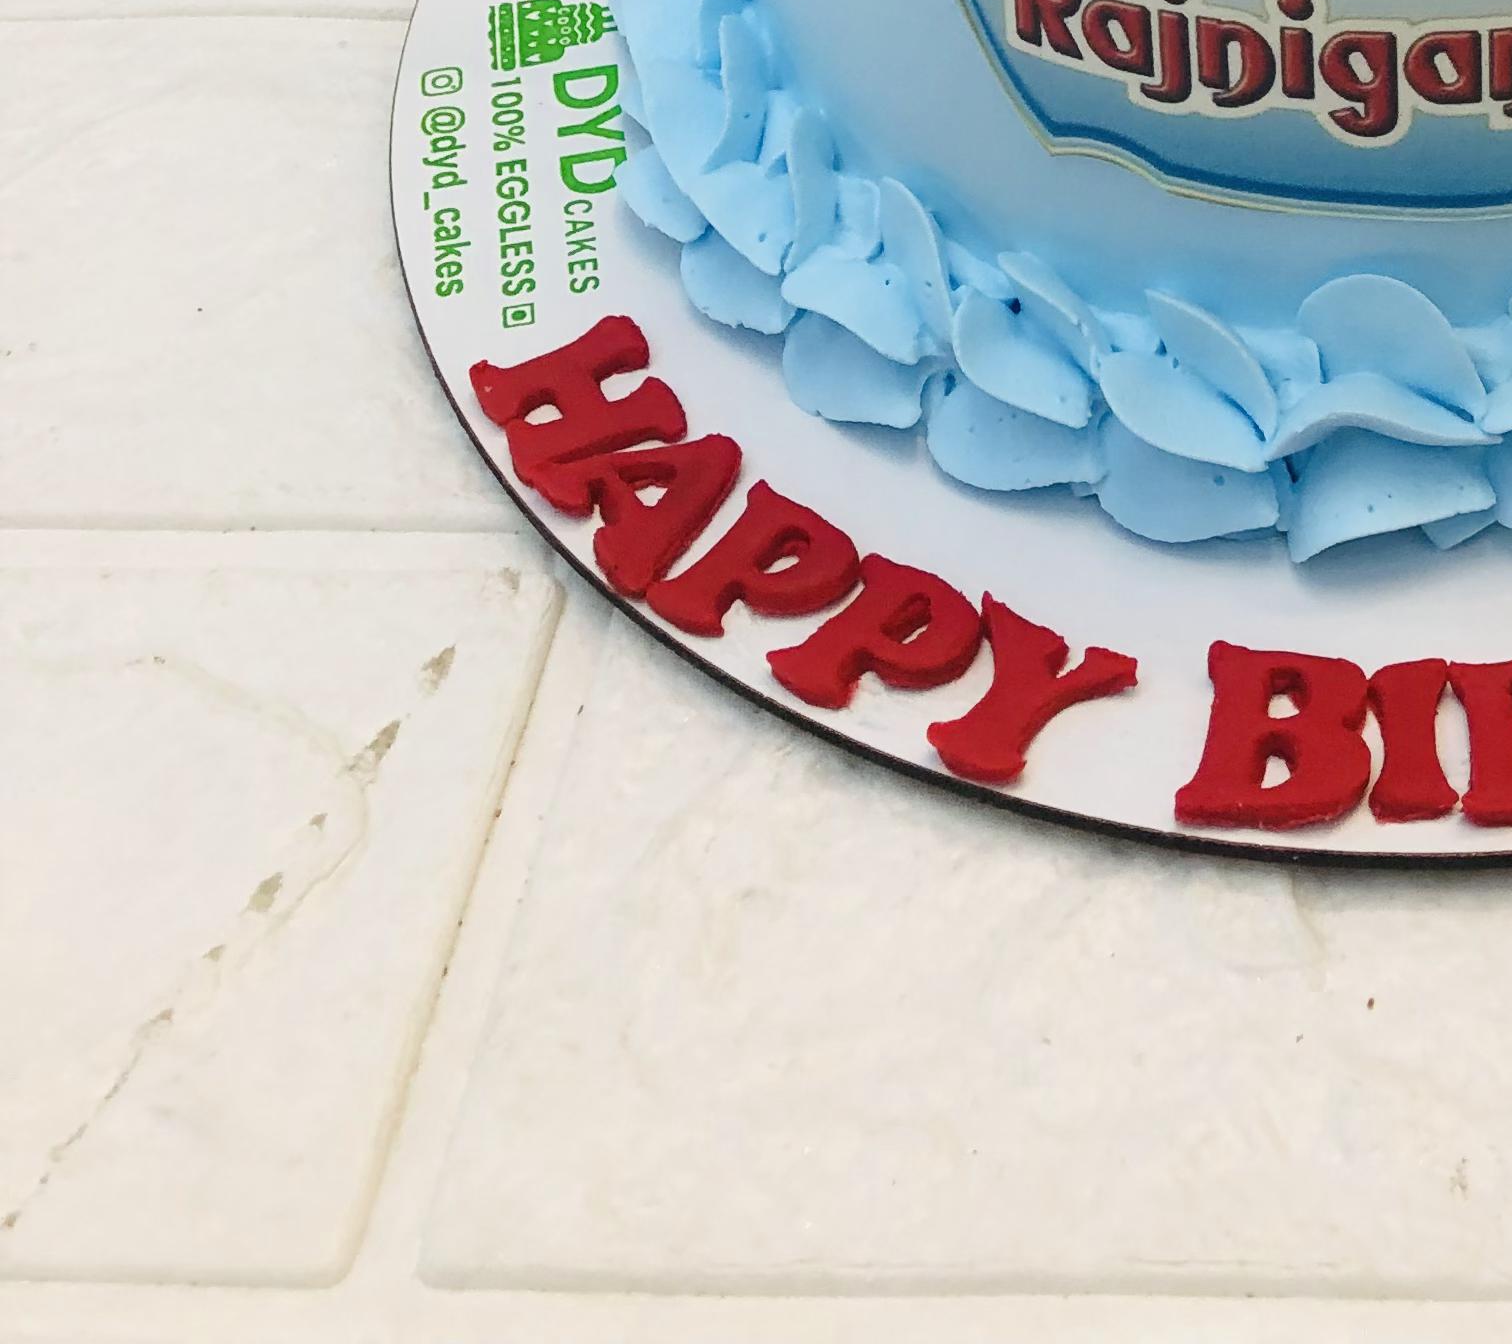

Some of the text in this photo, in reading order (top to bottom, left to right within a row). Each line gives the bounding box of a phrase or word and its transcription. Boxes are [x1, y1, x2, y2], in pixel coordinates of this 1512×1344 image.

[420, 105, 472, 299] @dyd_cakes
[490, 76, 537, 297] 100% EGGLESS
[552, 64, 628, 295] DYD CAKES
[469, 315, 1138, 785] HAPPY
